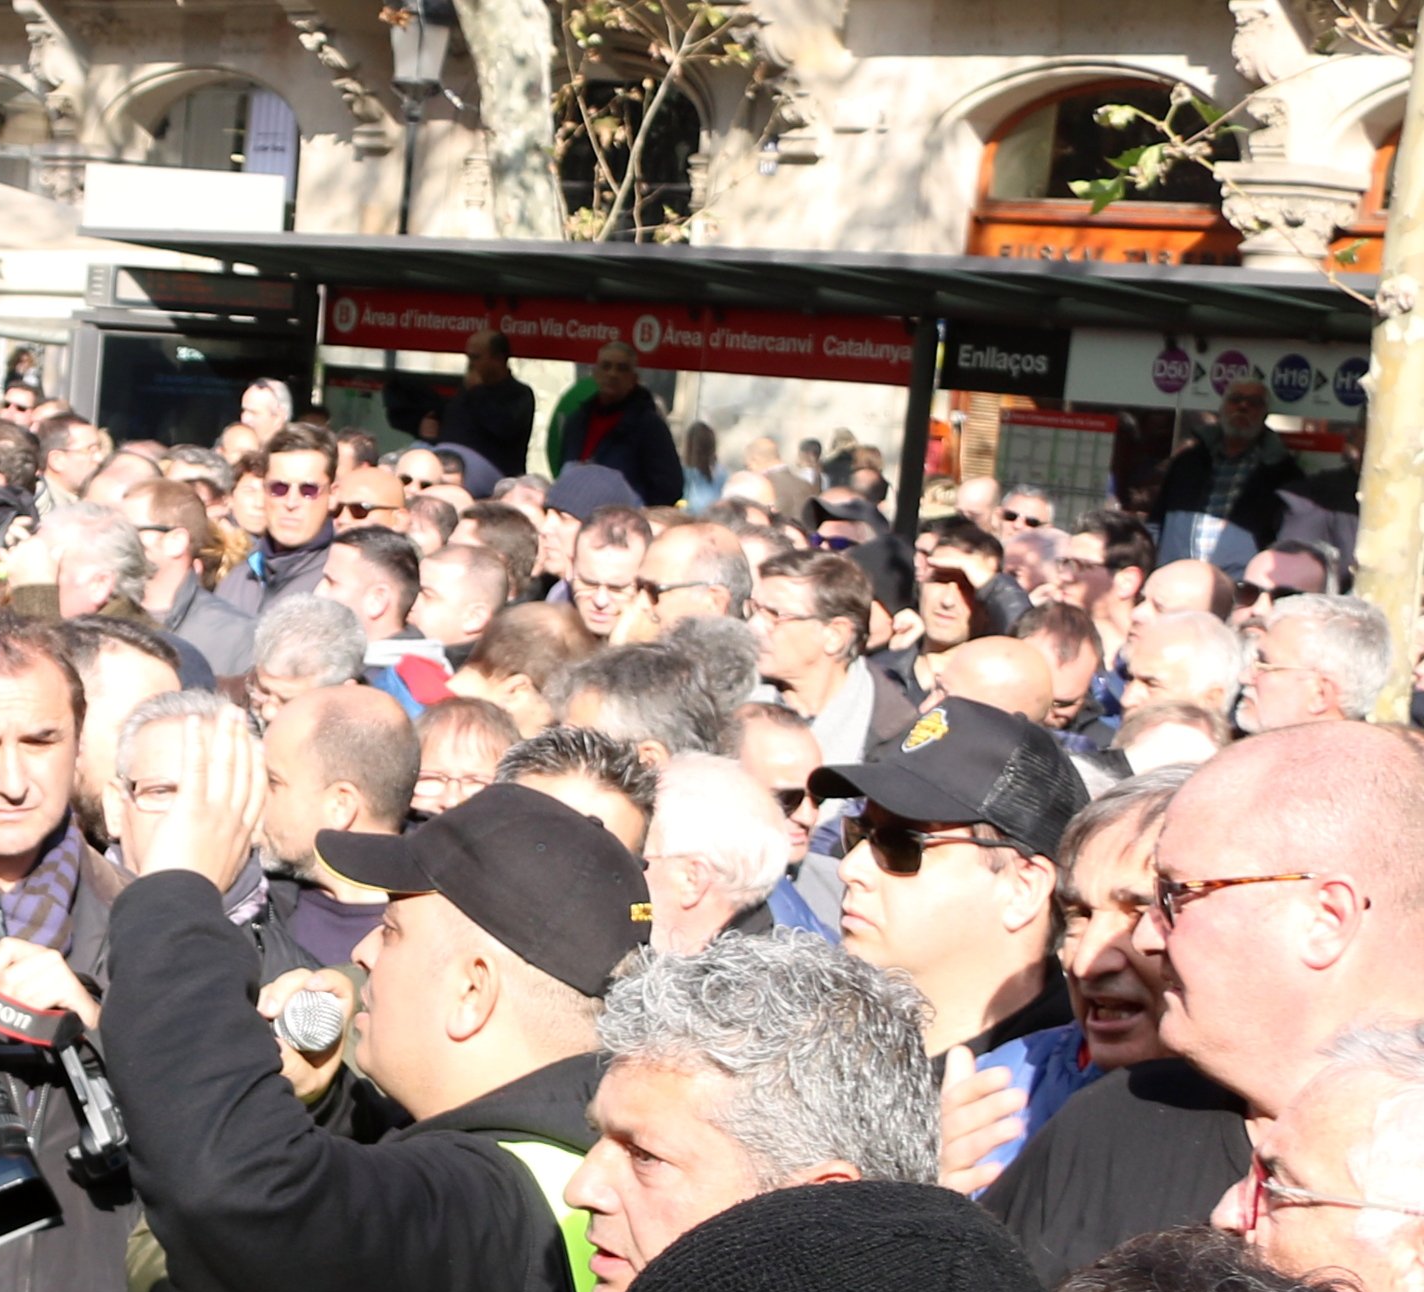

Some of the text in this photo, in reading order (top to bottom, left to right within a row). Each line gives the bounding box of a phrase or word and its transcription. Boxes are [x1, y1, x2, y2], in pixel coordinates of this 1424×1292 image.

[361, 304, 395, 327] Àrea
[400, 311, 490, 333] d'intercanvi
[500, 315, 537, 335] Gran
[540, 317, 564, 335] Via
[565, 319, 621, 341] Centre
[662, 319, 702, 347] Àrea
[709, 327, 814, 354] d'intercanvi
[822, 335, 912, 364] Catalunya
[957, 345, 1049, 378] Enllaços
[1154, 359, 1190, 380] D50
[1273, 368, 1309, 389] H16
